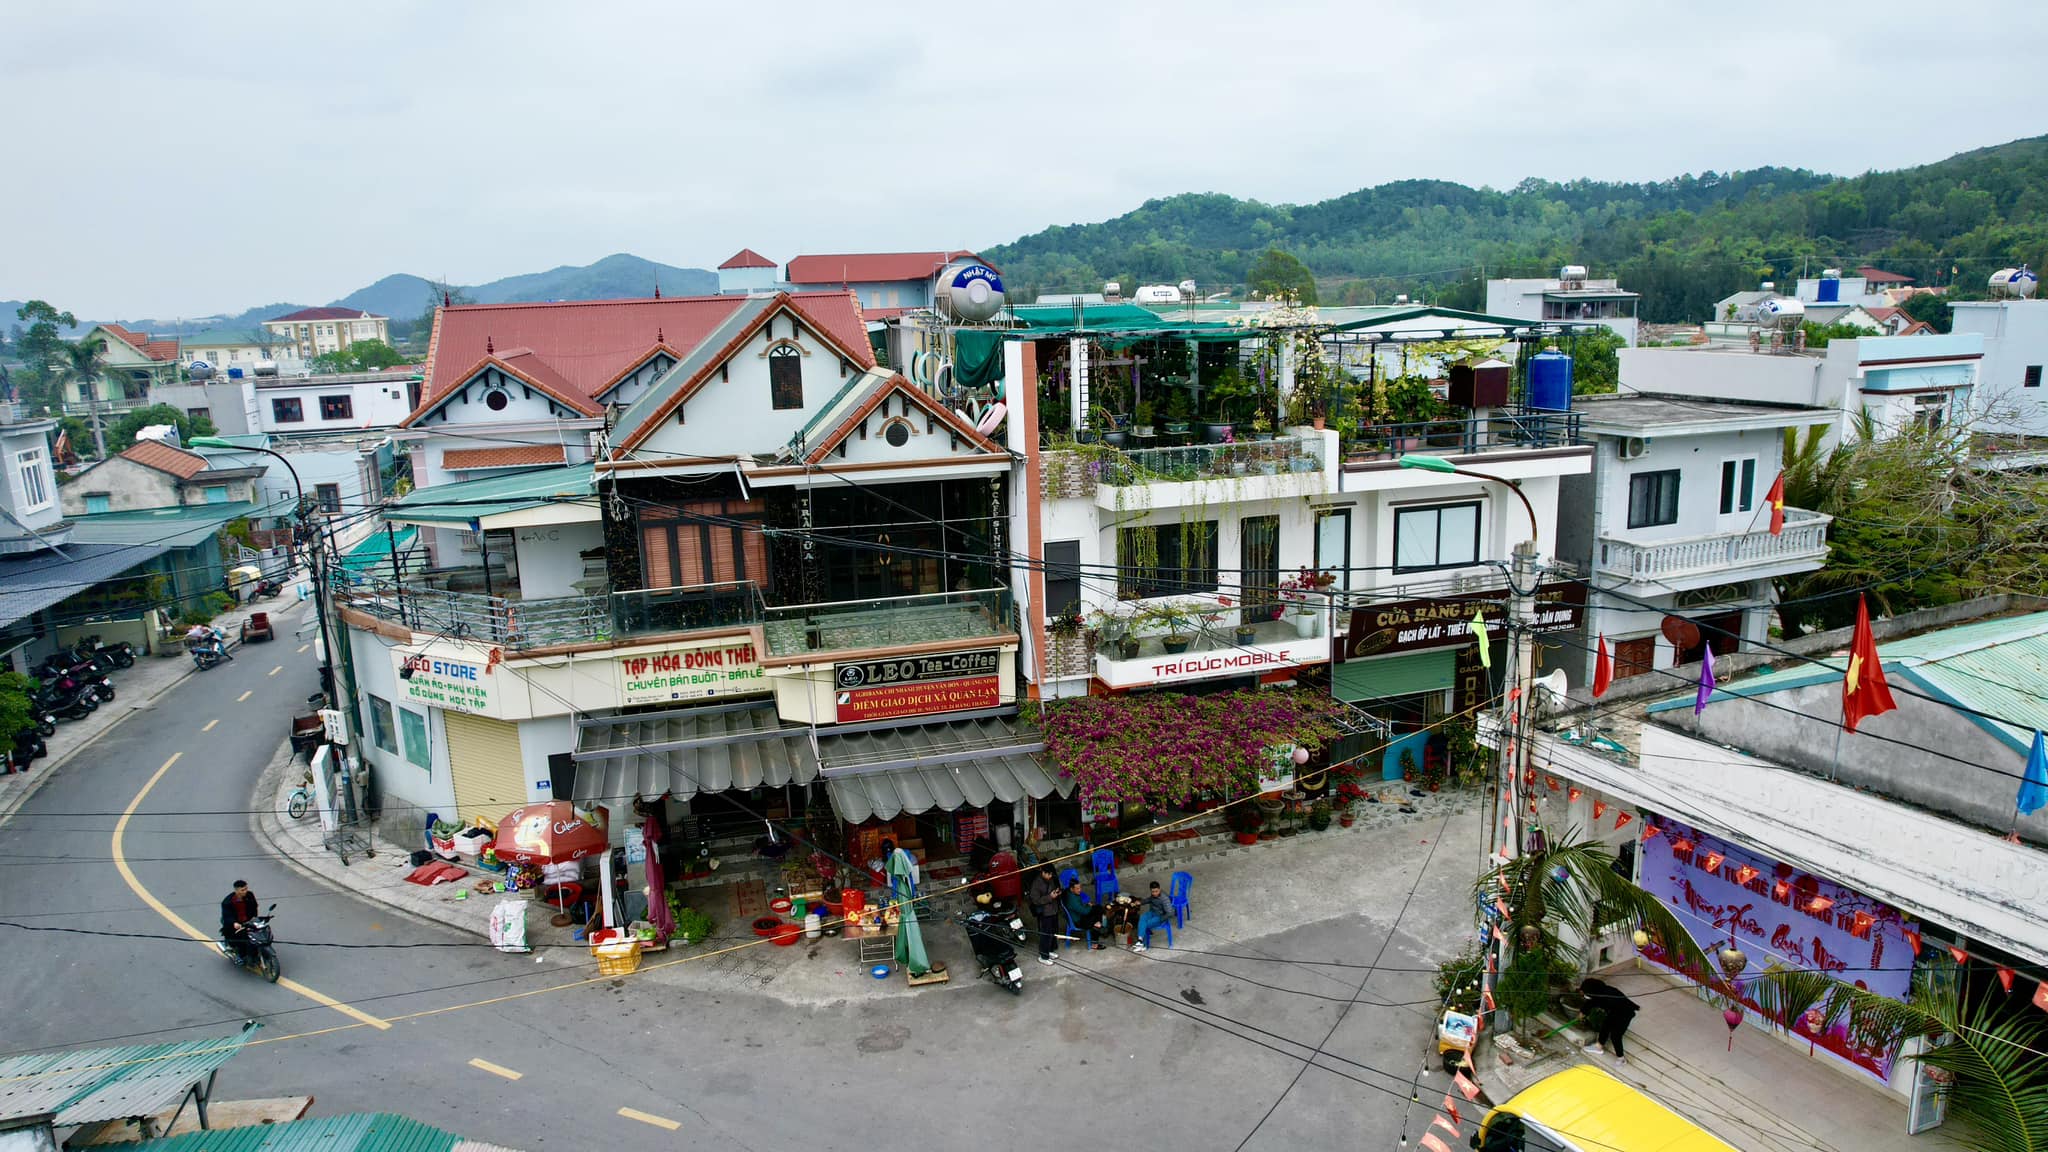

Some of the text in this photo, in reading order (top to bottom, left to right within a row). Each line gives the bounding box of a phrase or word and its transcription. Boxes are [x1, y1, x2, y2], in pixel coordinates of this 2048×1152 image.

[622, 657, 648, 680] TẠP
[1224, 650, 1290, 669] MOBILE
[433, 661, 477, 681] STORE
[627, 676, 668, 691] CHUYÊN
[669, 673, 690, 687] BÁN
[728, 668, 749, 681] BÁN
[867, 661, 915, 683] LEO
[880, 696, 906, 708] GIAO
[907, 693, 931, 706] DỊCH
